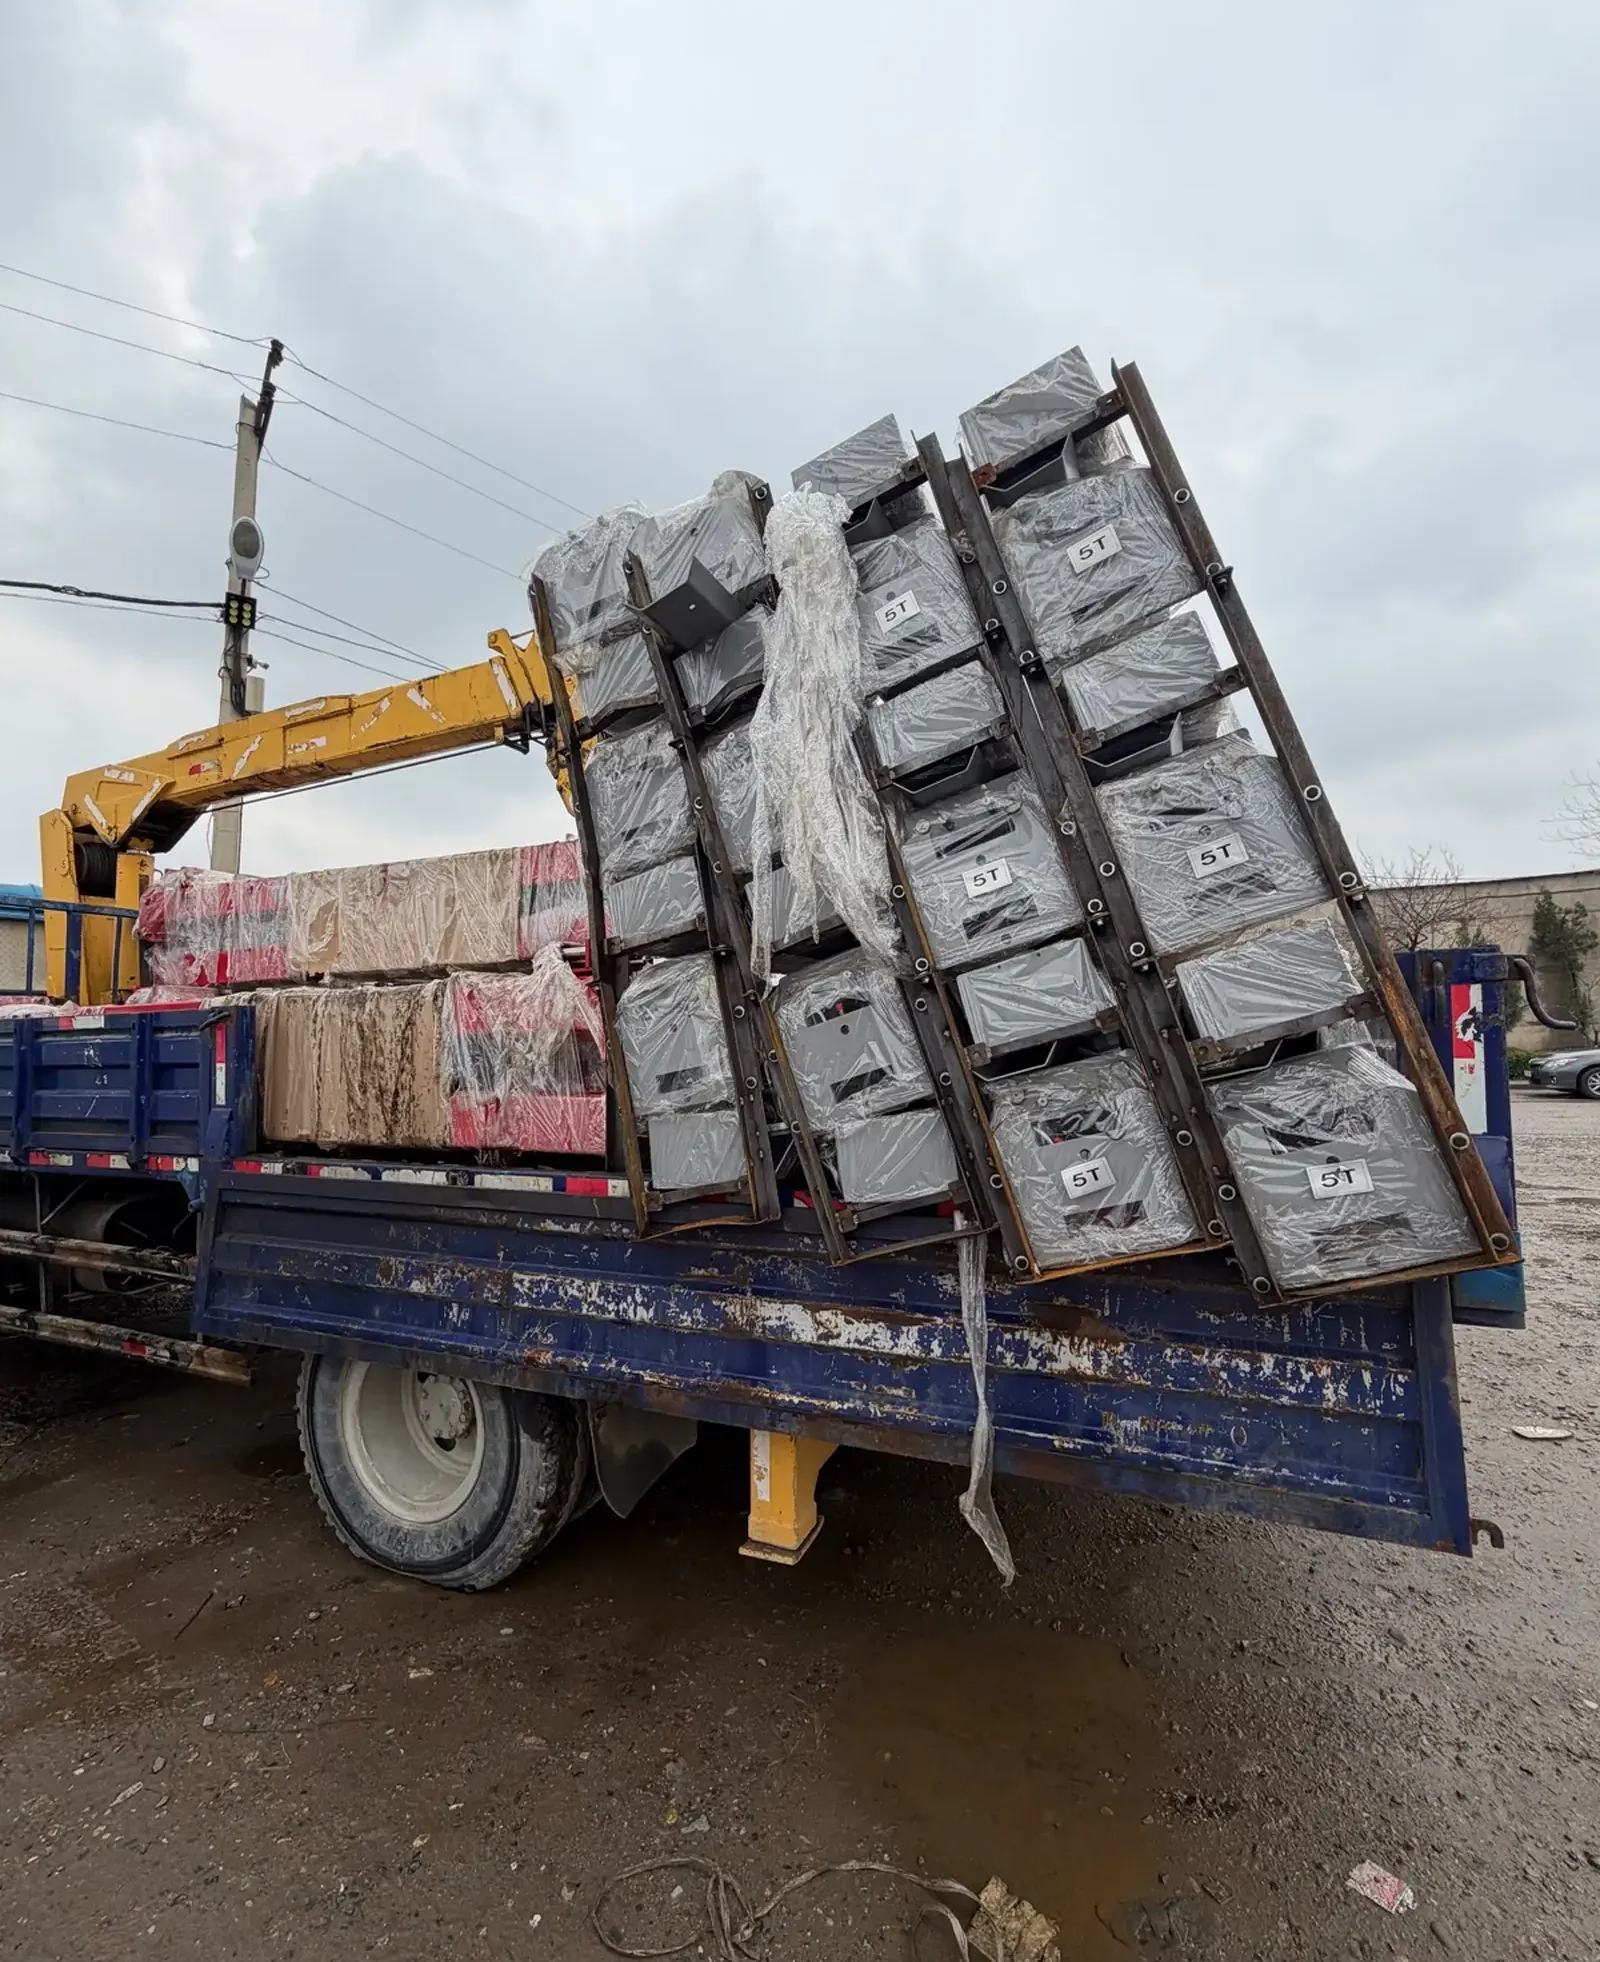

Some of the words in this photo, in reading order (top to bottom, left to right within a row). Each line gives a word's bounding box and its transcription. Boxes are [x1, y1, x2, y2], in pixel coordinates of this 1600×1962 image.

[1079, 535, 1107, 561] 5T
[884, 599, 908, 622] 5T
[1201, 843, 1233, 866] 5T
[973, 867, 999, 887] 5T
[1072, 1167, 1100, 1188] 5T
[1321, 1168, 1356, 1188] 5T
